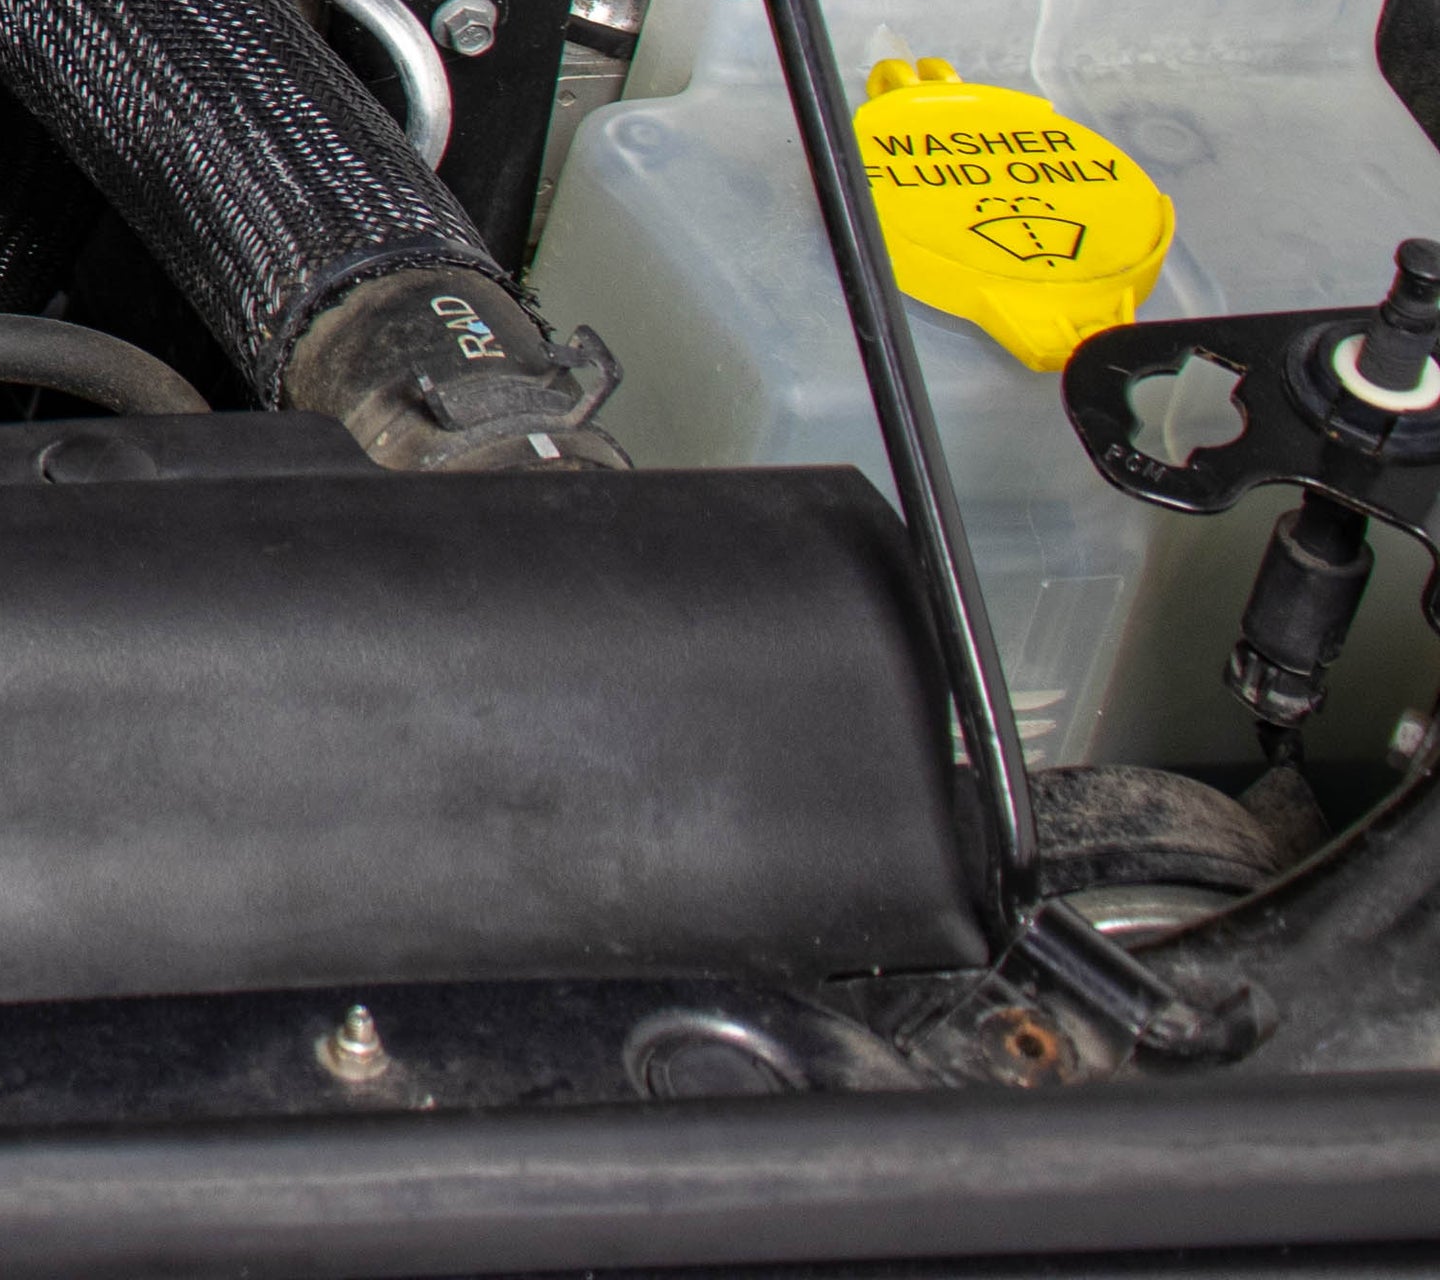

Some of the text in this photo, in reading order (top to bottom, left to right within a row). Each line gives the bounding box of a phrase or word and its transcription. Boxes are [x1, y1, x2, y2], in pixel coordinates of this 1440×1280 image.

[872, 130, 1077, 156] WASHER
[863, 159, 1120, 188] FLUID ONLY
[430, 295, 506, 361] RAD
